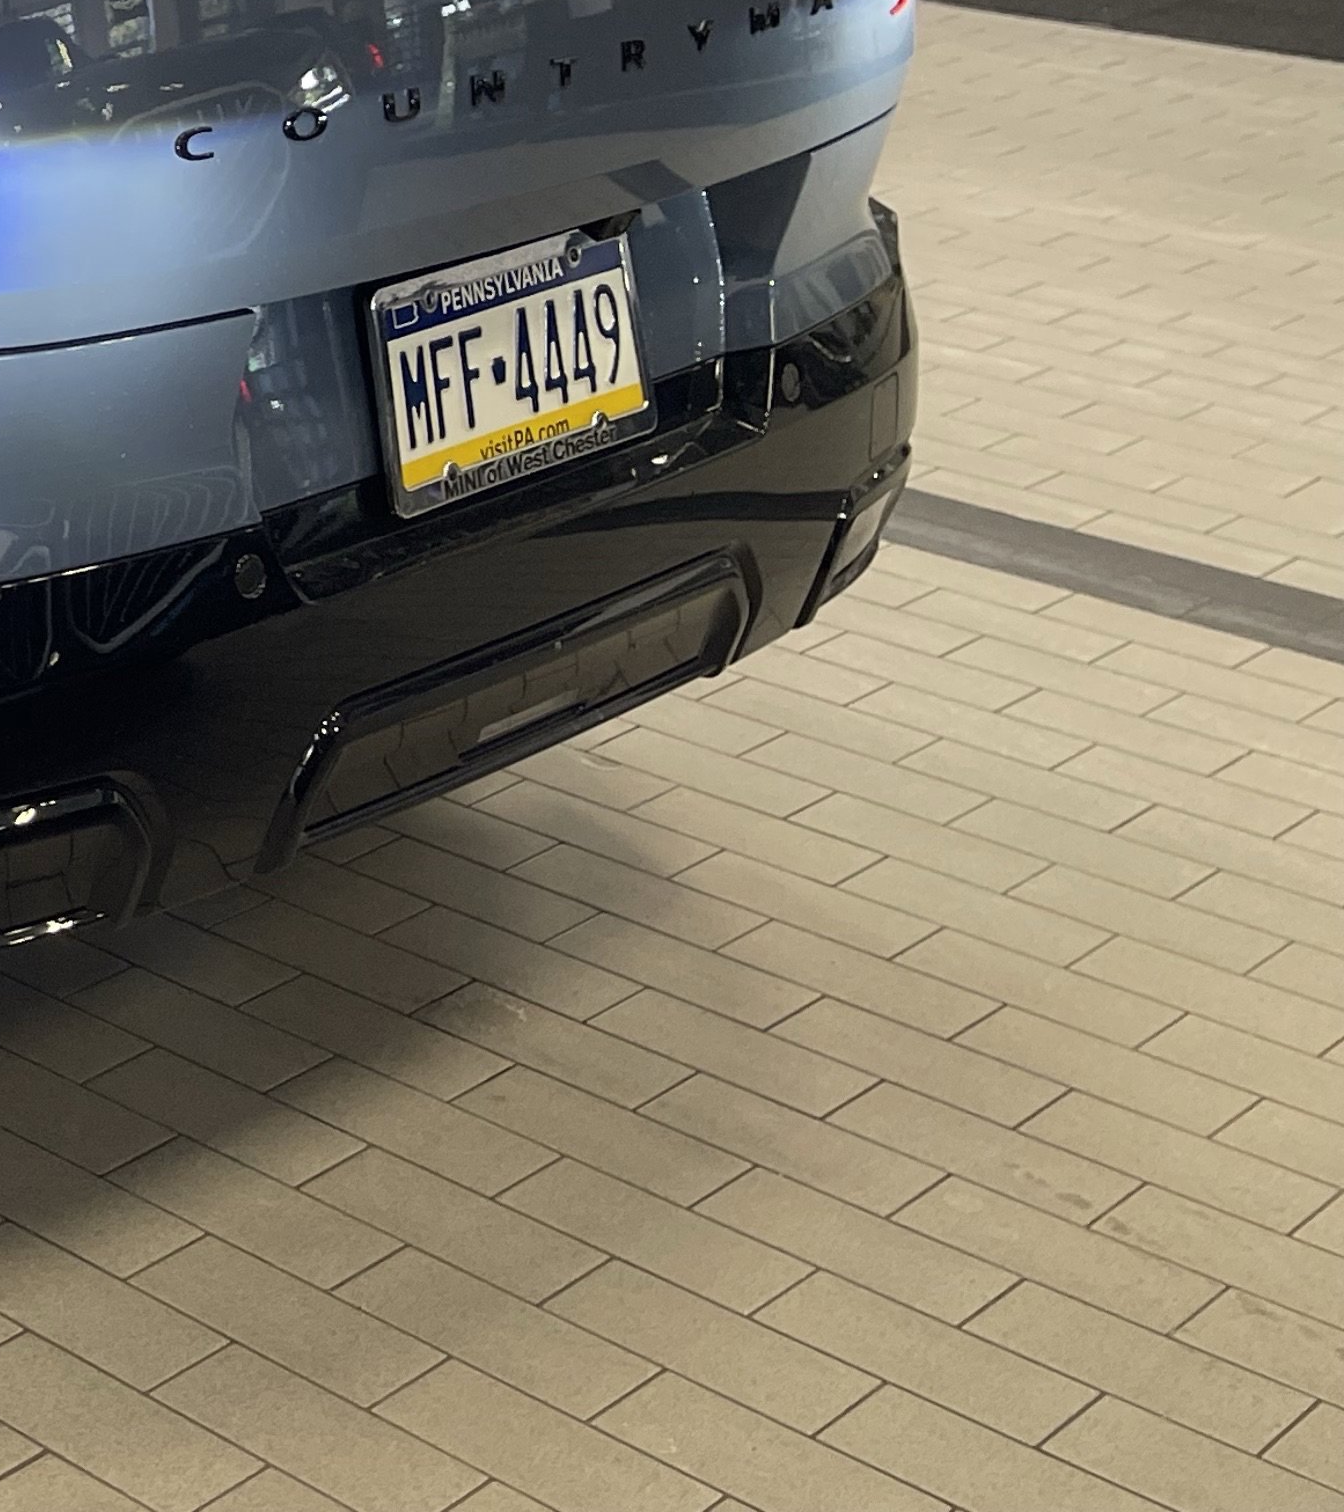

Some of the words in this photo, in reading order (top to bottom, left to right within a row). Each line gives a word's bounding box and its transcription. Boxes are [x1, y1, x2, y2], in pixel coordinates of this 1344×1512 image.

[440, 256, 564, 314] PENNSYLVANIA
[443, 471, 485, 501] MINI
[486, 462, 506, 484] of
[508, 446, 551, 477] West
[552, 427, 617, 460] Chester
[479, 418, 571, 461] visitPA.com
